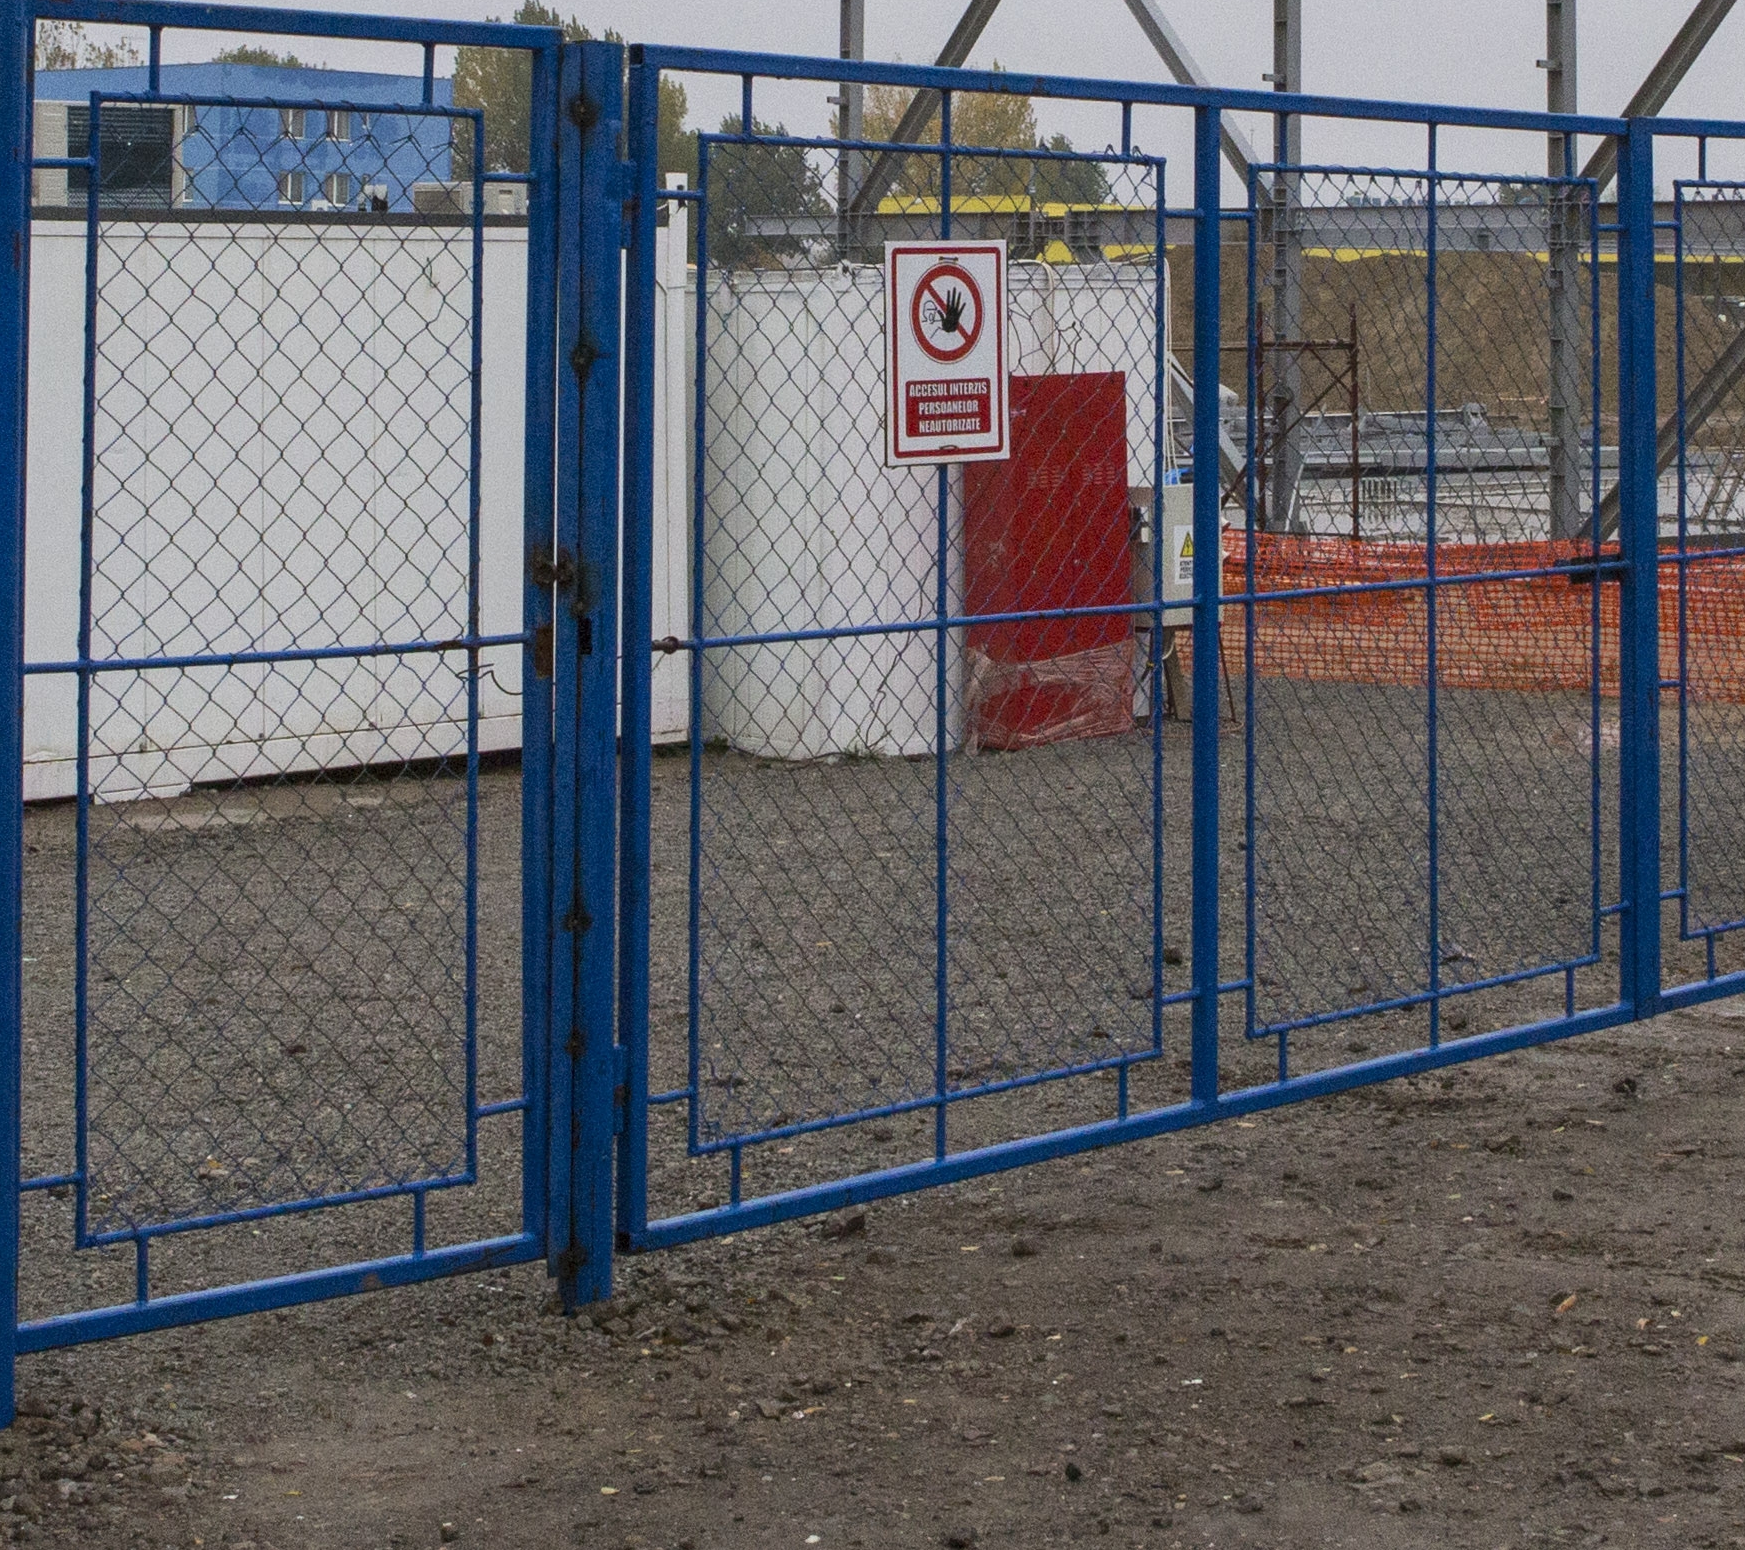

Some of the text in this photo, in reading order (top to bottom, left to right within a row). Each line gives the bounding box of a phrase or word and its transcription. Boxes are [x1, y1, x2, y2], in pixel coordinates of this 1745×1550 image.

[909, 381, 988, 397] ACCESUL INTERZIS
[918, 399, 979, 415] PERSOANELOR
[919, 417, 981, 433] NEAUTORIZATE
